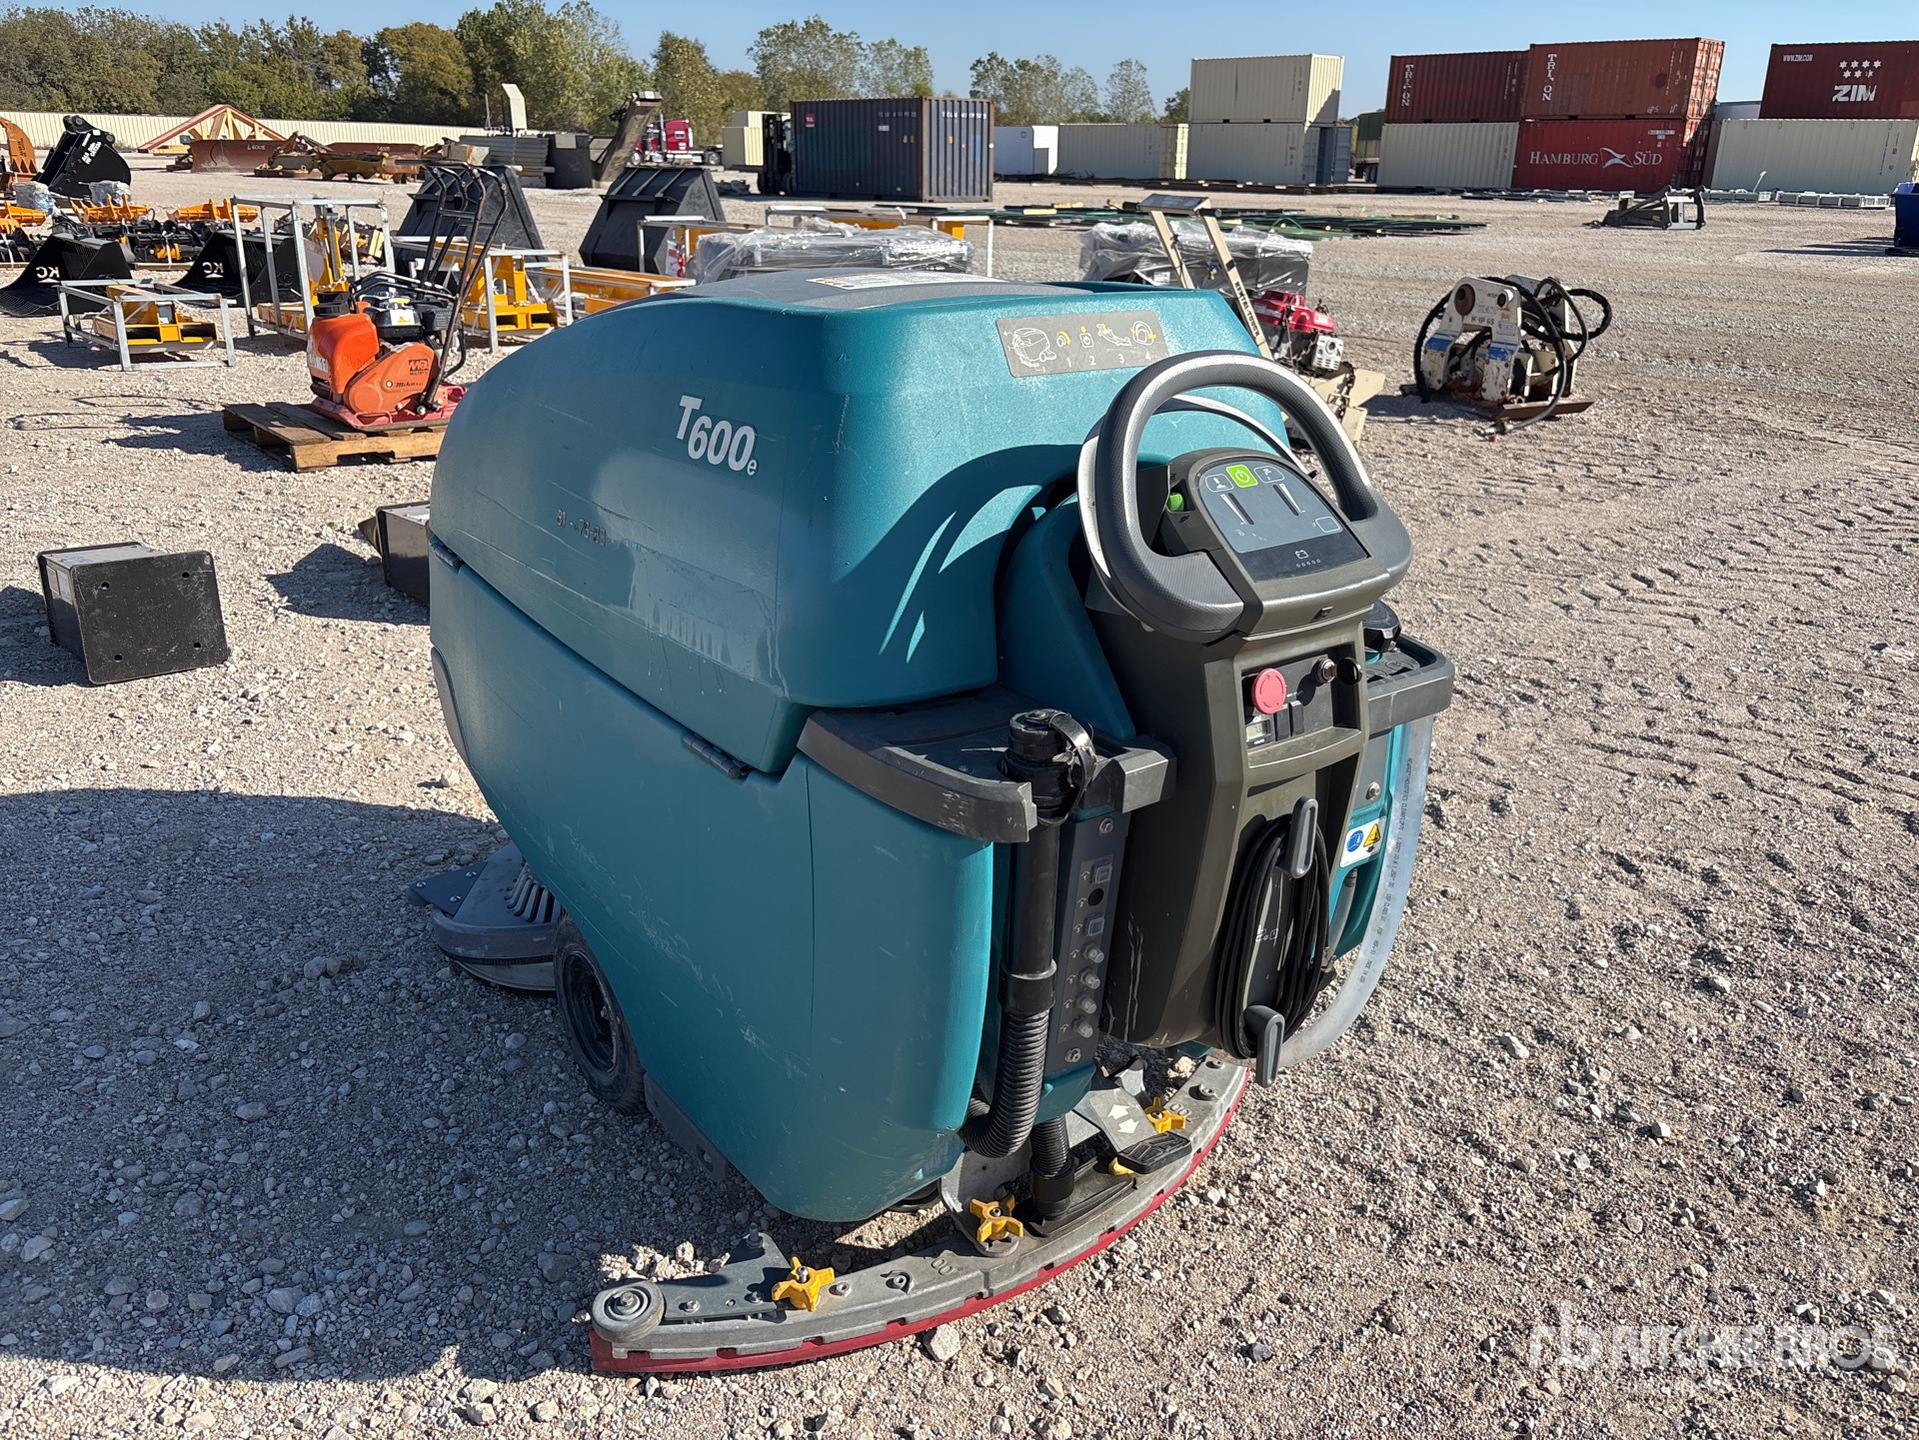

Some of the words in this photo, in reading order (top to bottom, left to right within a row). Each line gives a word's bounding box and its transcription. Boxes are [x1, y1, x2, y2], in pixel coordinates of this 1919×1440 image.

[1542, 53, 1558, 101] TRION
[1832, 84, 1877, 102] ZIM
[1529, 151, 1599, 165] HAMBURG
[1633, 150, 1662, 166] SÜD
[1066, 357, 1073, 368] 1
[1089, 355, 1097, 366] 2
[1118, 353, 1126, 364] 3
[1144, 351, 1152, 361] 4
